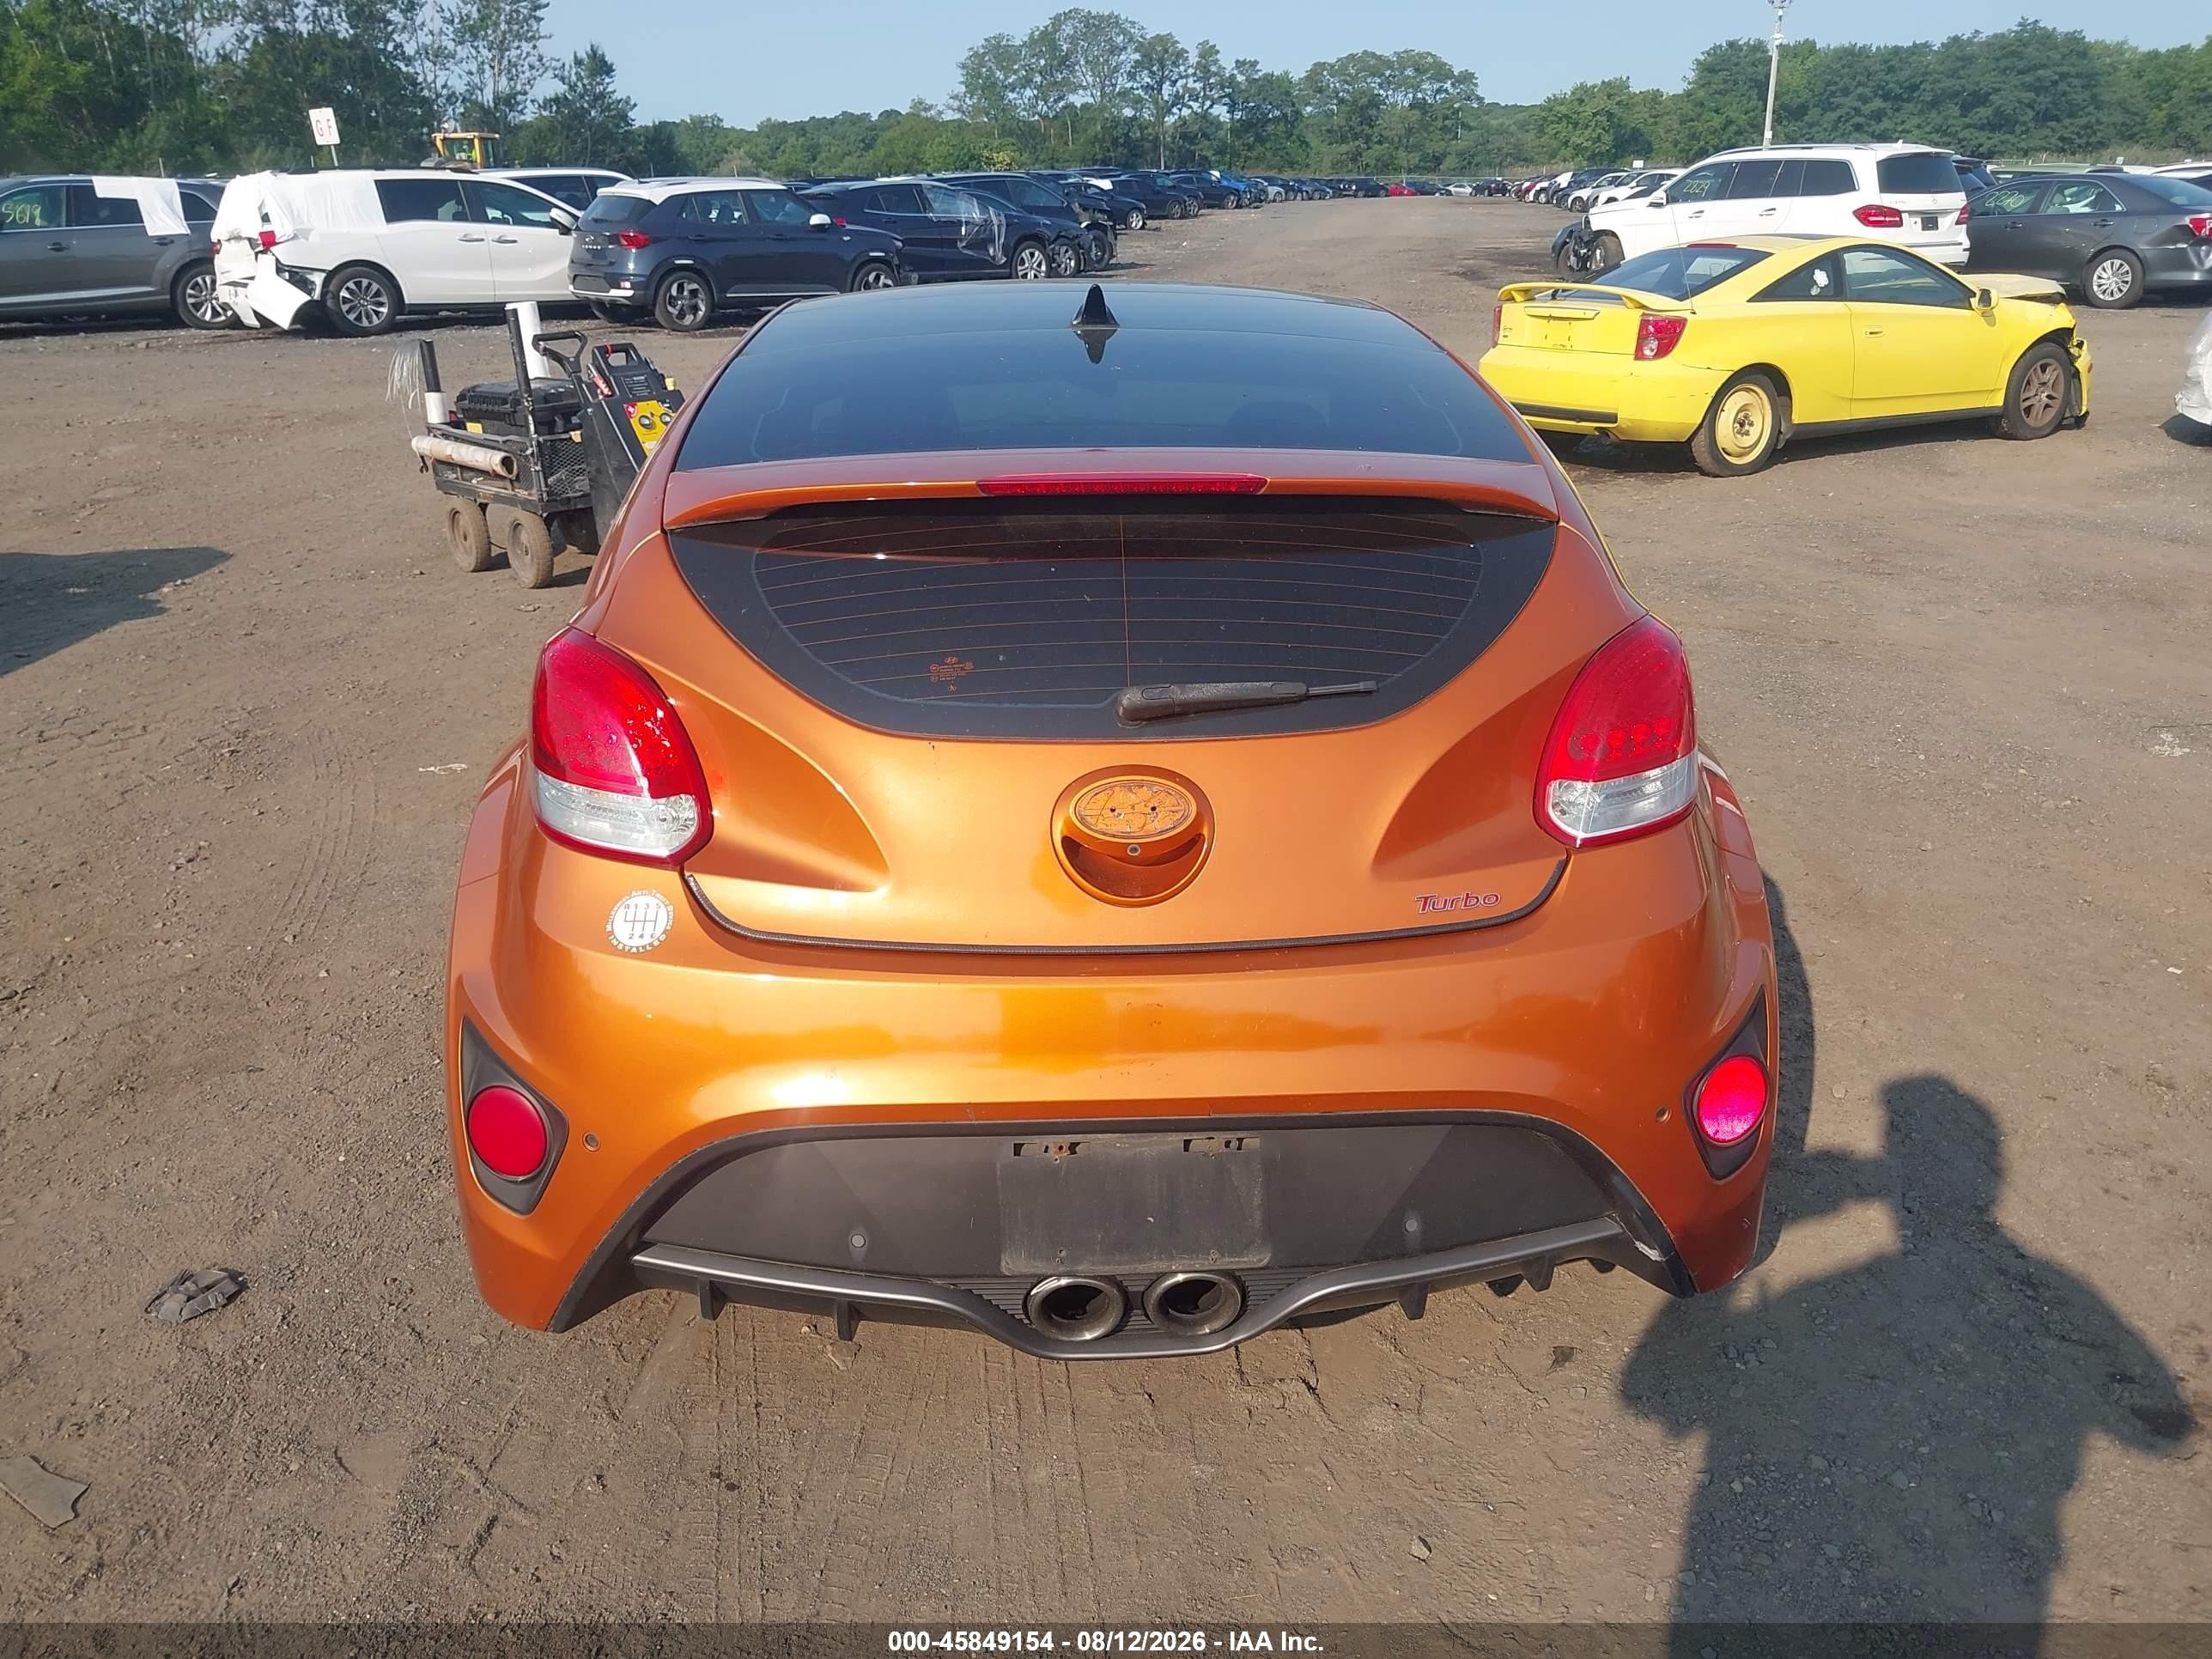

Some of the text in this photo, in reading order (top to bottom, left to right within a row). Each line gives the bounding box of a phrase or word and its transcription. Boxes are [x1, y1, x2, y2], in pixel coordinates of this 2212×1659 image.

[2, 203, 42, 227] 5619
[1414, 892, 1502, 914] Turbo
[608, 933, 666, 953] INSTALLED
